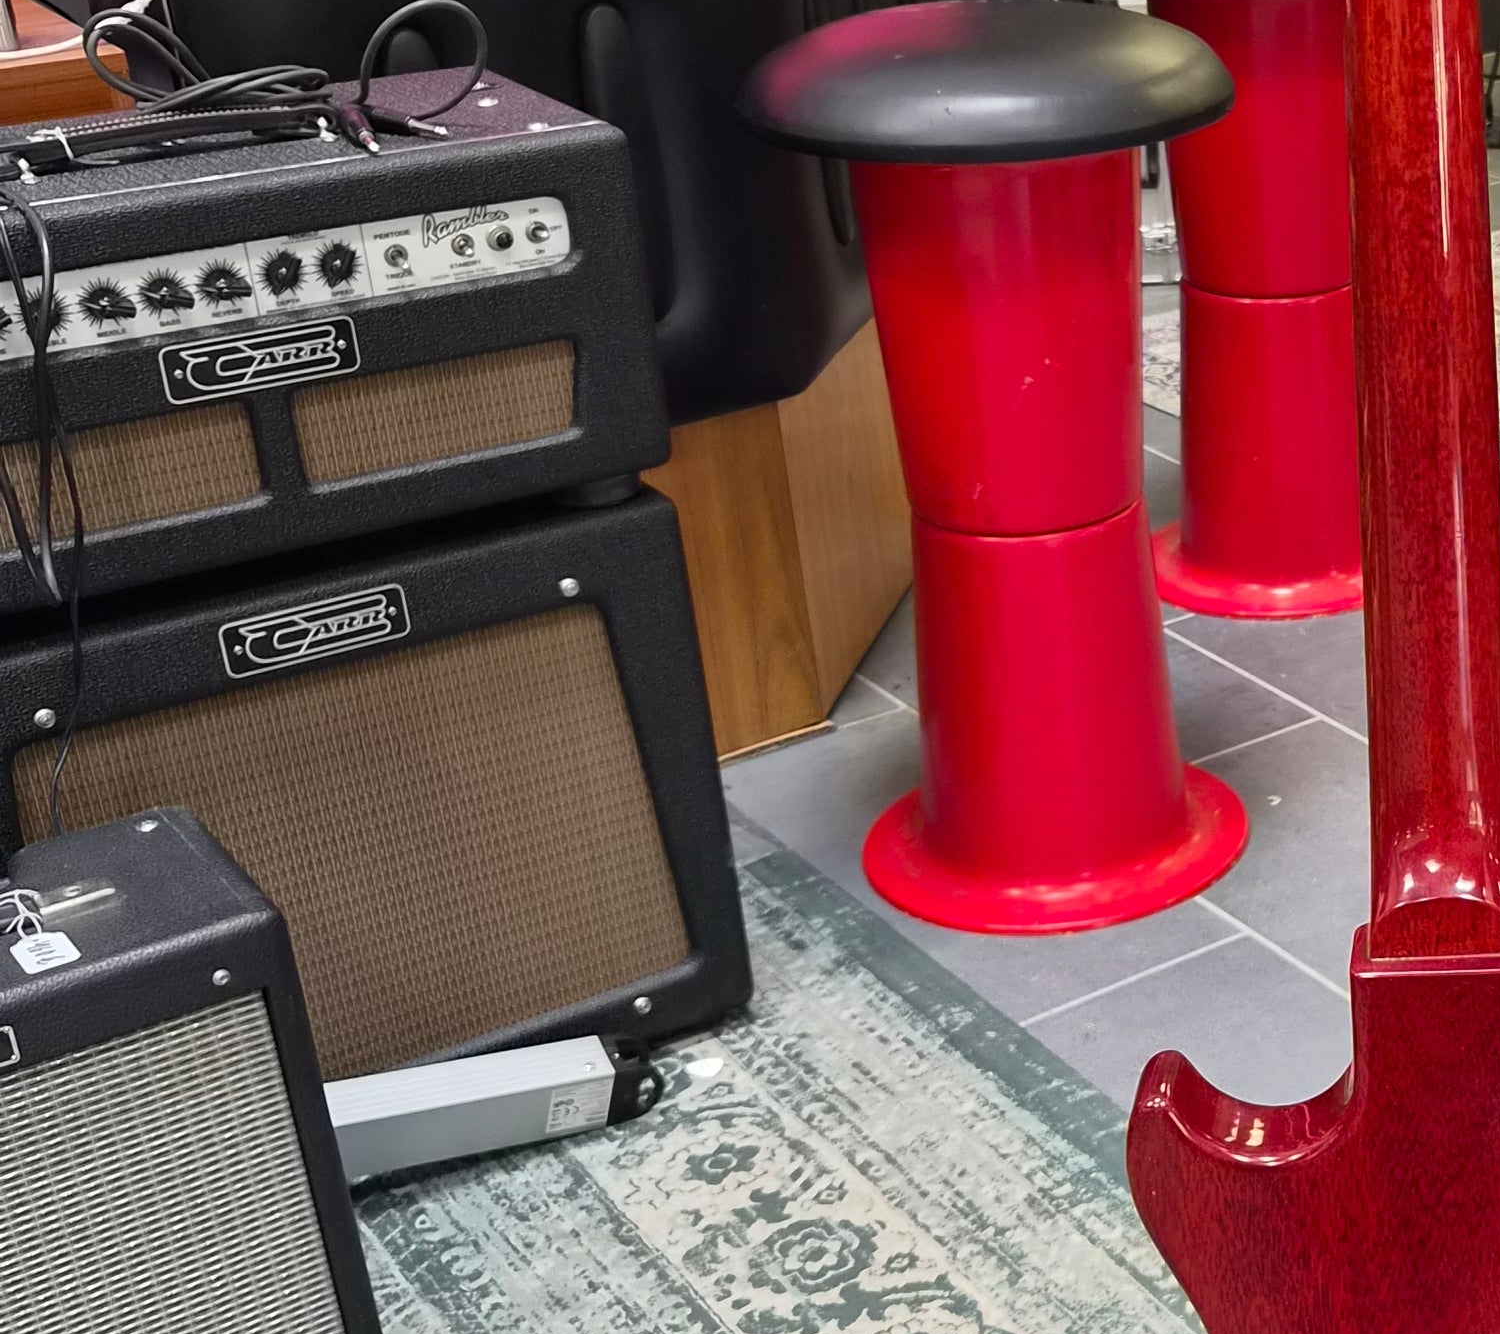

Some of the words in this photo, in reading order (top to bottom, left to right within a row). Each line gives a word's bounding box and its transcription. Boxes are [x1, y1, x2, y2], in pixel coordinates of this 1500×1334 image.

[373, 228, 411, 240] PENTODE
[422, 205, 510, 248] Rambler
[179, 325, 341, 391] CARR
[238, 594, 392, 664] CARR
